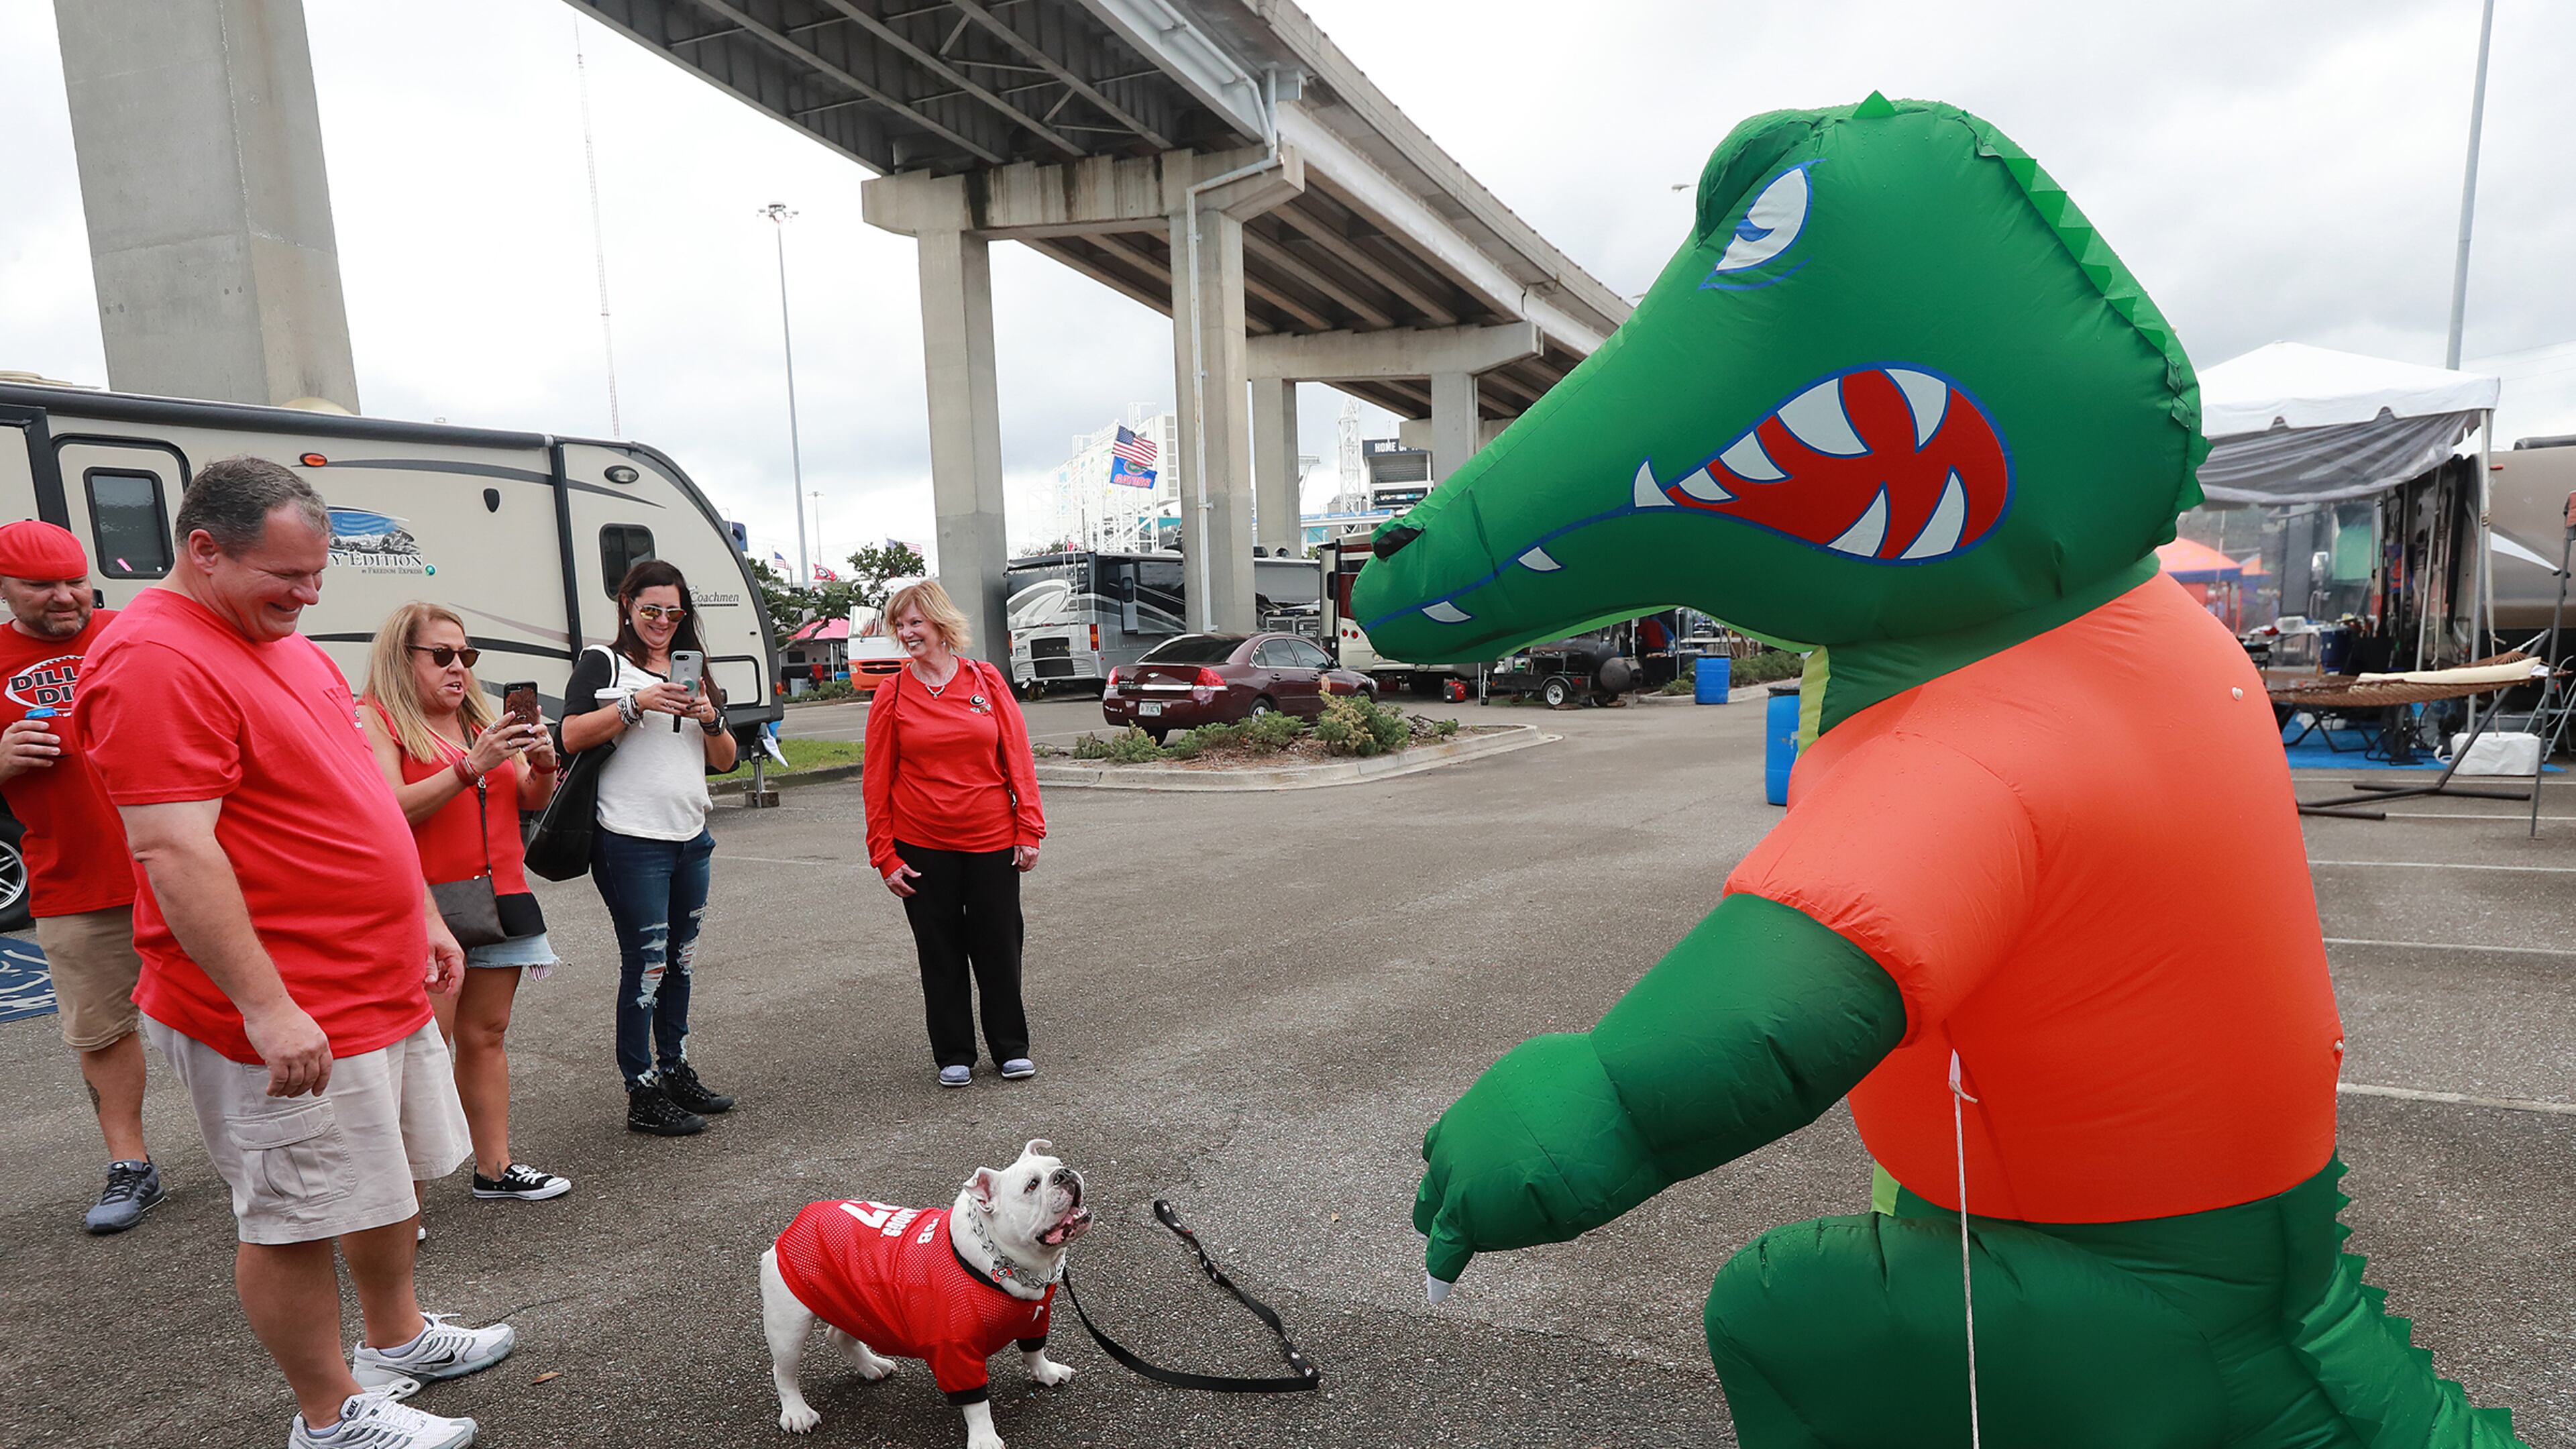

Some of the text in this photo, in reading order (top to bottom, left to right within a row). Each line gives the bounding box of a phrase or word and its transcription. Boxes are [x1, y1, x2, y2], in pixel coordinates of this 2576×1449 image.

[1375, 442, 1396, 453] HOME
[348, 551, 423, 567] EDITION
[691, 591, 739, 602] Coachmen
[9, 666, 78, 692] DILL
[35, 684, 75, 706] DI
[346, 1399, 359, 1417] NIKE
